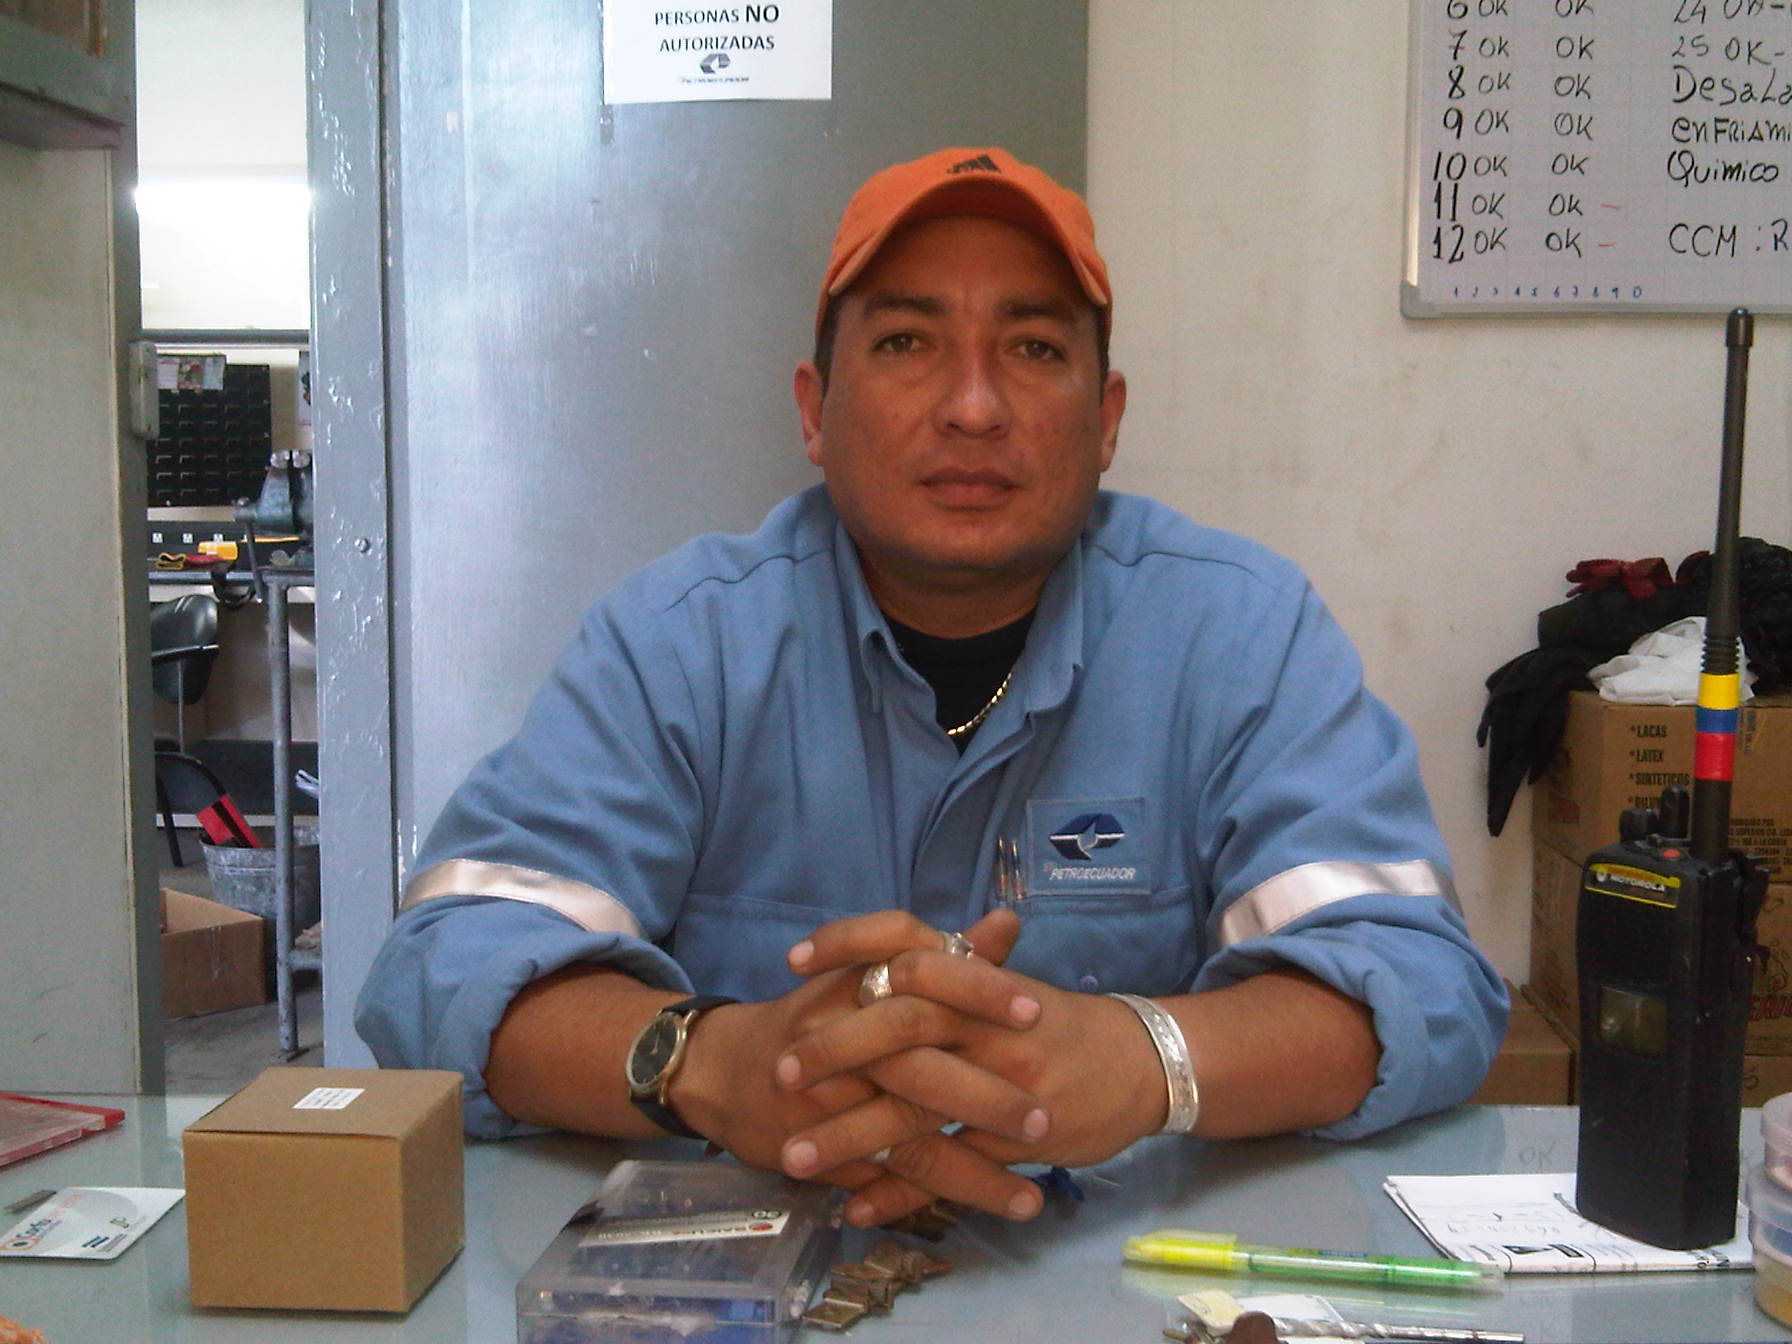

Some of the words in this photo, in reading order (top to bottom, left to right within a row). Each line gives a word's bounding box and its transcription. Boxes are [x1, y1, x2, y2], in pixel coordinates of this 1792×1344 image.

[655, 9, 740, 26] PERSONAS
[745, 4, 780, 23] NO
[1478, 0, 1508, 17] OK
[1555, 0, 1594, 18] OK
[659, 35, 775, 52] AUTORIZADAS
[1448, 30, 1468, 60] 7
[1478, 35, 1510, 58] OK
[1556, 35, 1594, 60] OK
[1672, 34, 1709, 58] 25
[1448, 64, 1465, 99] 8
[1478, 71, 1511, 94] OK
[1554, 73, 1591, 99] OK
[1443, 107, 1463, 139] 9
[1474, 108, 1509, 135] OK
[1554, 112, 1593, 141] OK
[1433, 151, 1467, 181] 10
[1473, 156, 1507, 177] OK
[1551, 153, 1589, 175] OK
[1667, 149, 1779, 188] Quimico
[1434, 181, 1458, 221] 11
[1471, 192, 1505, 219] OK
[1548, 193, 1583, 216] OK
[1433, 224, 1465, 264] 12
[1474, 227, 1508, 254] OK
[1545, 227, 1582, 258] OK
[1669, 223, 1737, 257] CCM
[1637, 725, 1667, 738] LACAS
[1636, 749, 1664, 762] LATEX
[1635, 772, 1690, 786] SINTETICOS
